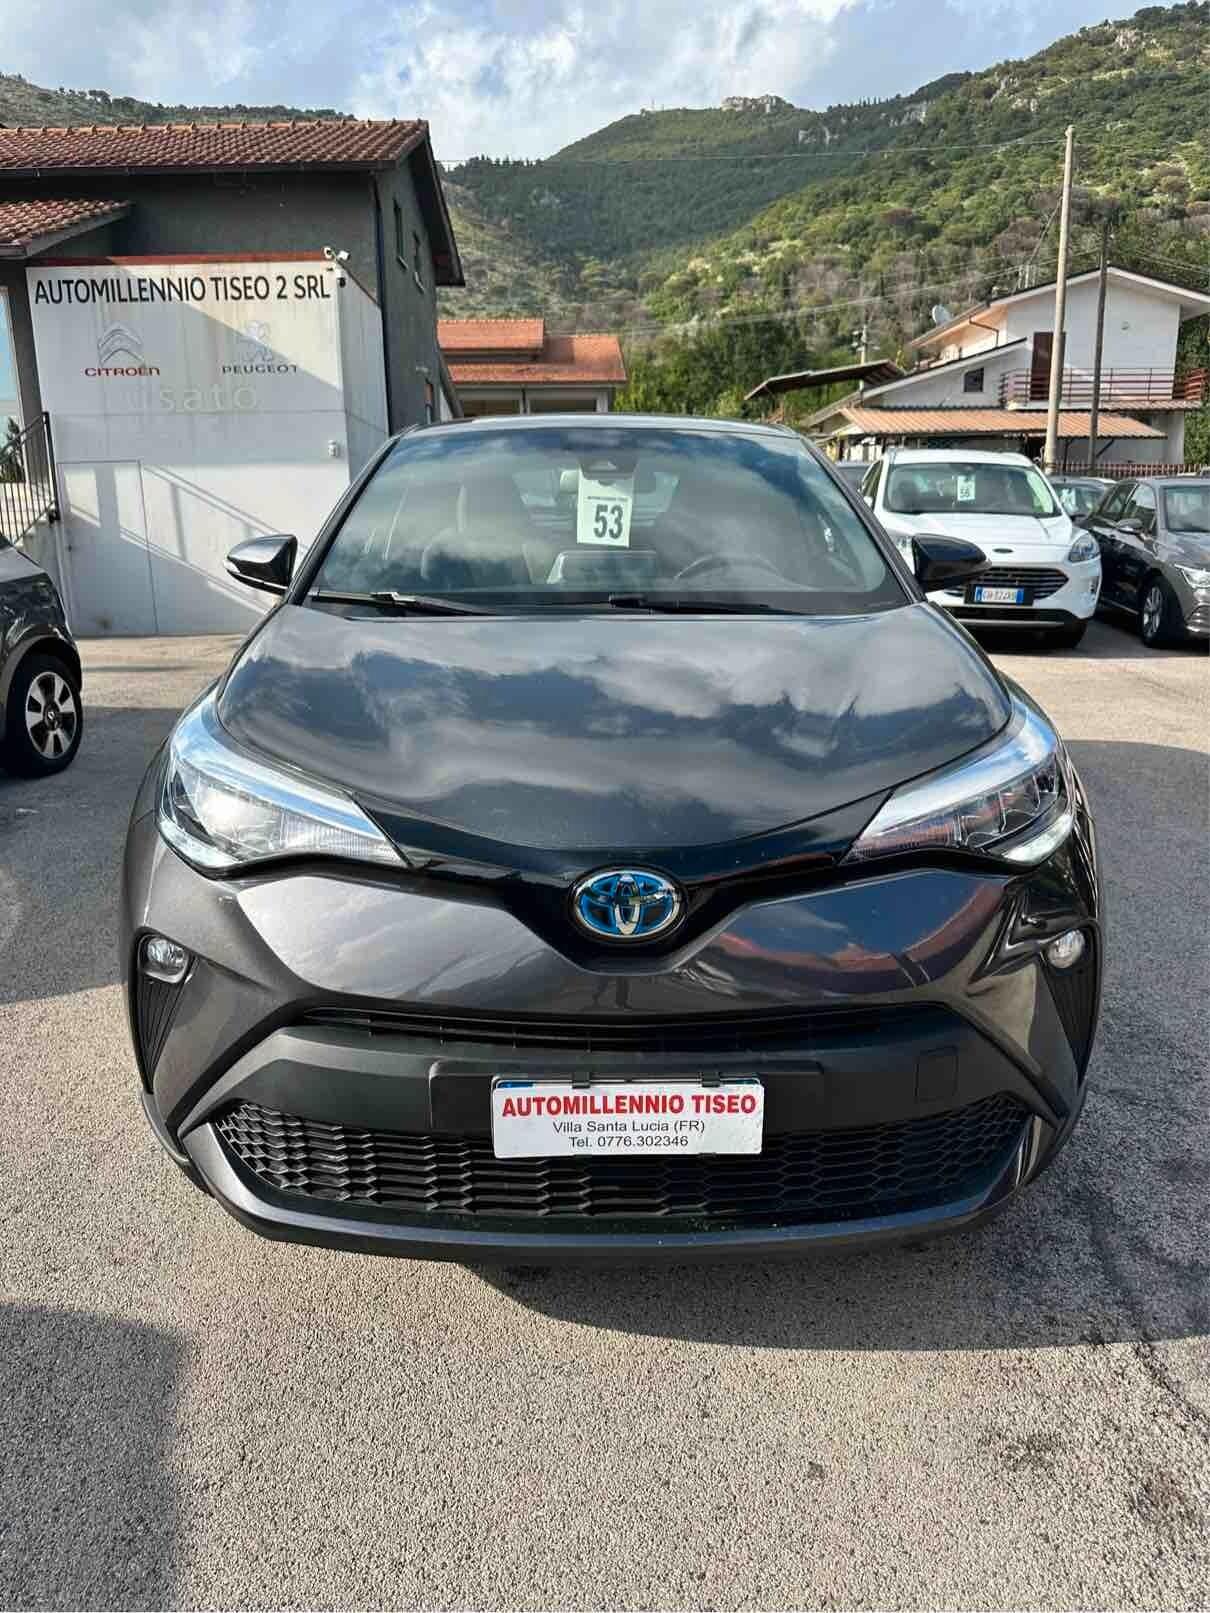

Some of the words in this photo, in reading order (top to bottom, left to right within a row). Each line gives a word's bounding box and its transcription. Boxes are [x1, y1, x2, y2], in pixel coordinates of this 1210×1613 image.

[34, 277, 206, 304] AUTOMILLENNIO
[210, 275, 270, 301] TISEO
[276, 275, 288, 300] 2
[294, 274, 331, 300] SRL
[221, 364, 297, 375] PEUGEOT
[593, 503, 624, 540] 53
[502, 1094, 685, 1117] AUTOMILLENNIO
[691, 1094, 757, 1115] TISEO
[552, 1120, 582, 1134] Villa
[587, 1120, 628, 1133] Santa
[632, 1120, 670, 1132] Lucia
[673, 1119, 706, 1134] (FR)
[569, 1136, 592, 1148] Tel.
[597, 1135, 689, 1148] 0776.302346
